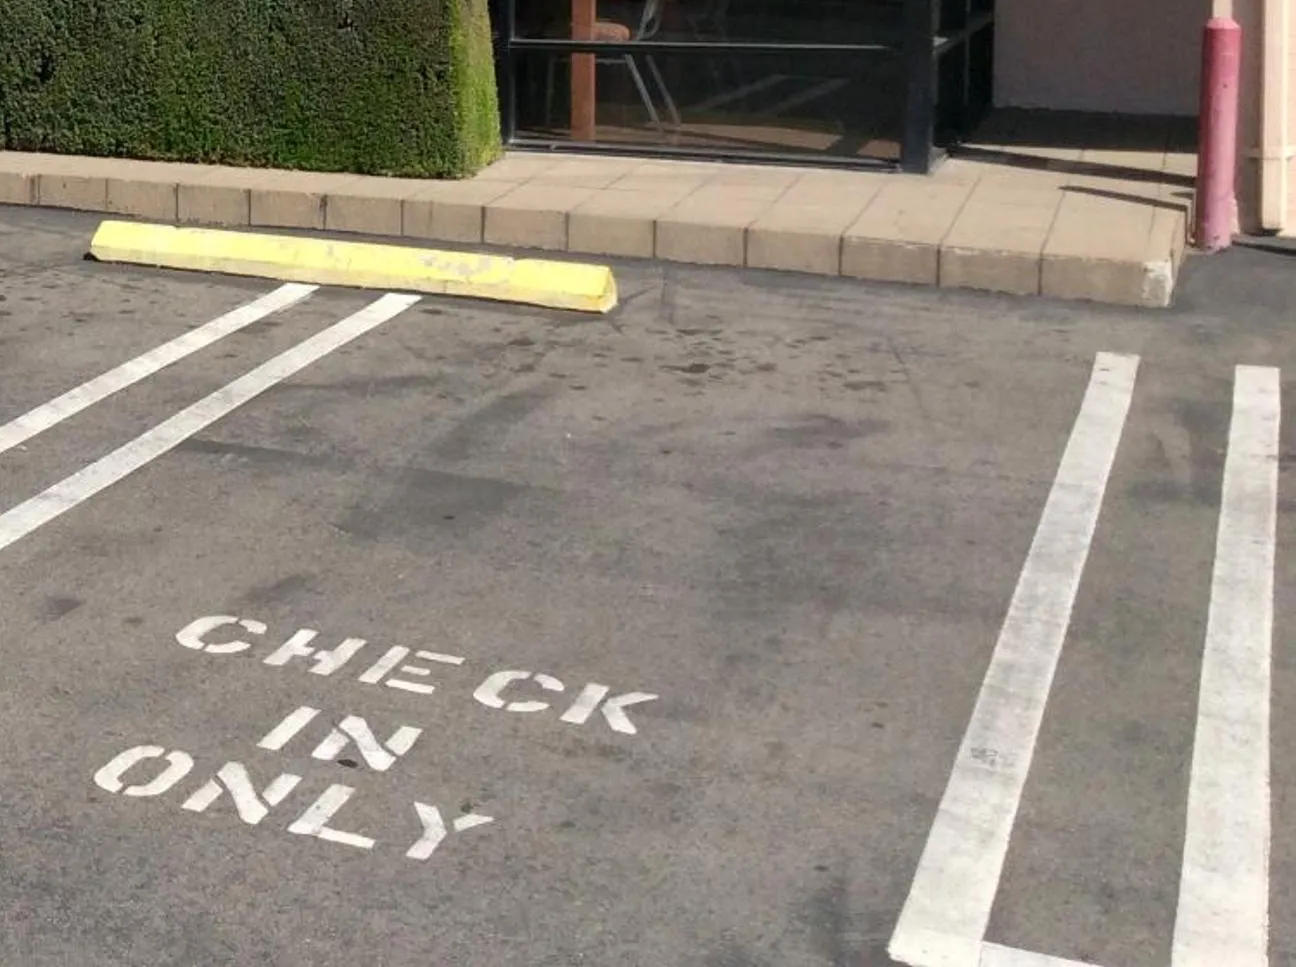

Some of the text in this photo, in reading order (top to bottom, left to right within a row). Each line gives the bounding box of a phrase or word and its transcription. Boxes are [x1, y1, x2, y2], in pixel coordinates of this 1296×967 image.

[175, 615, 659, 735] CHECK
[256, 706, 423, 772] IN
[93, 745, 494, 861] ONLY
